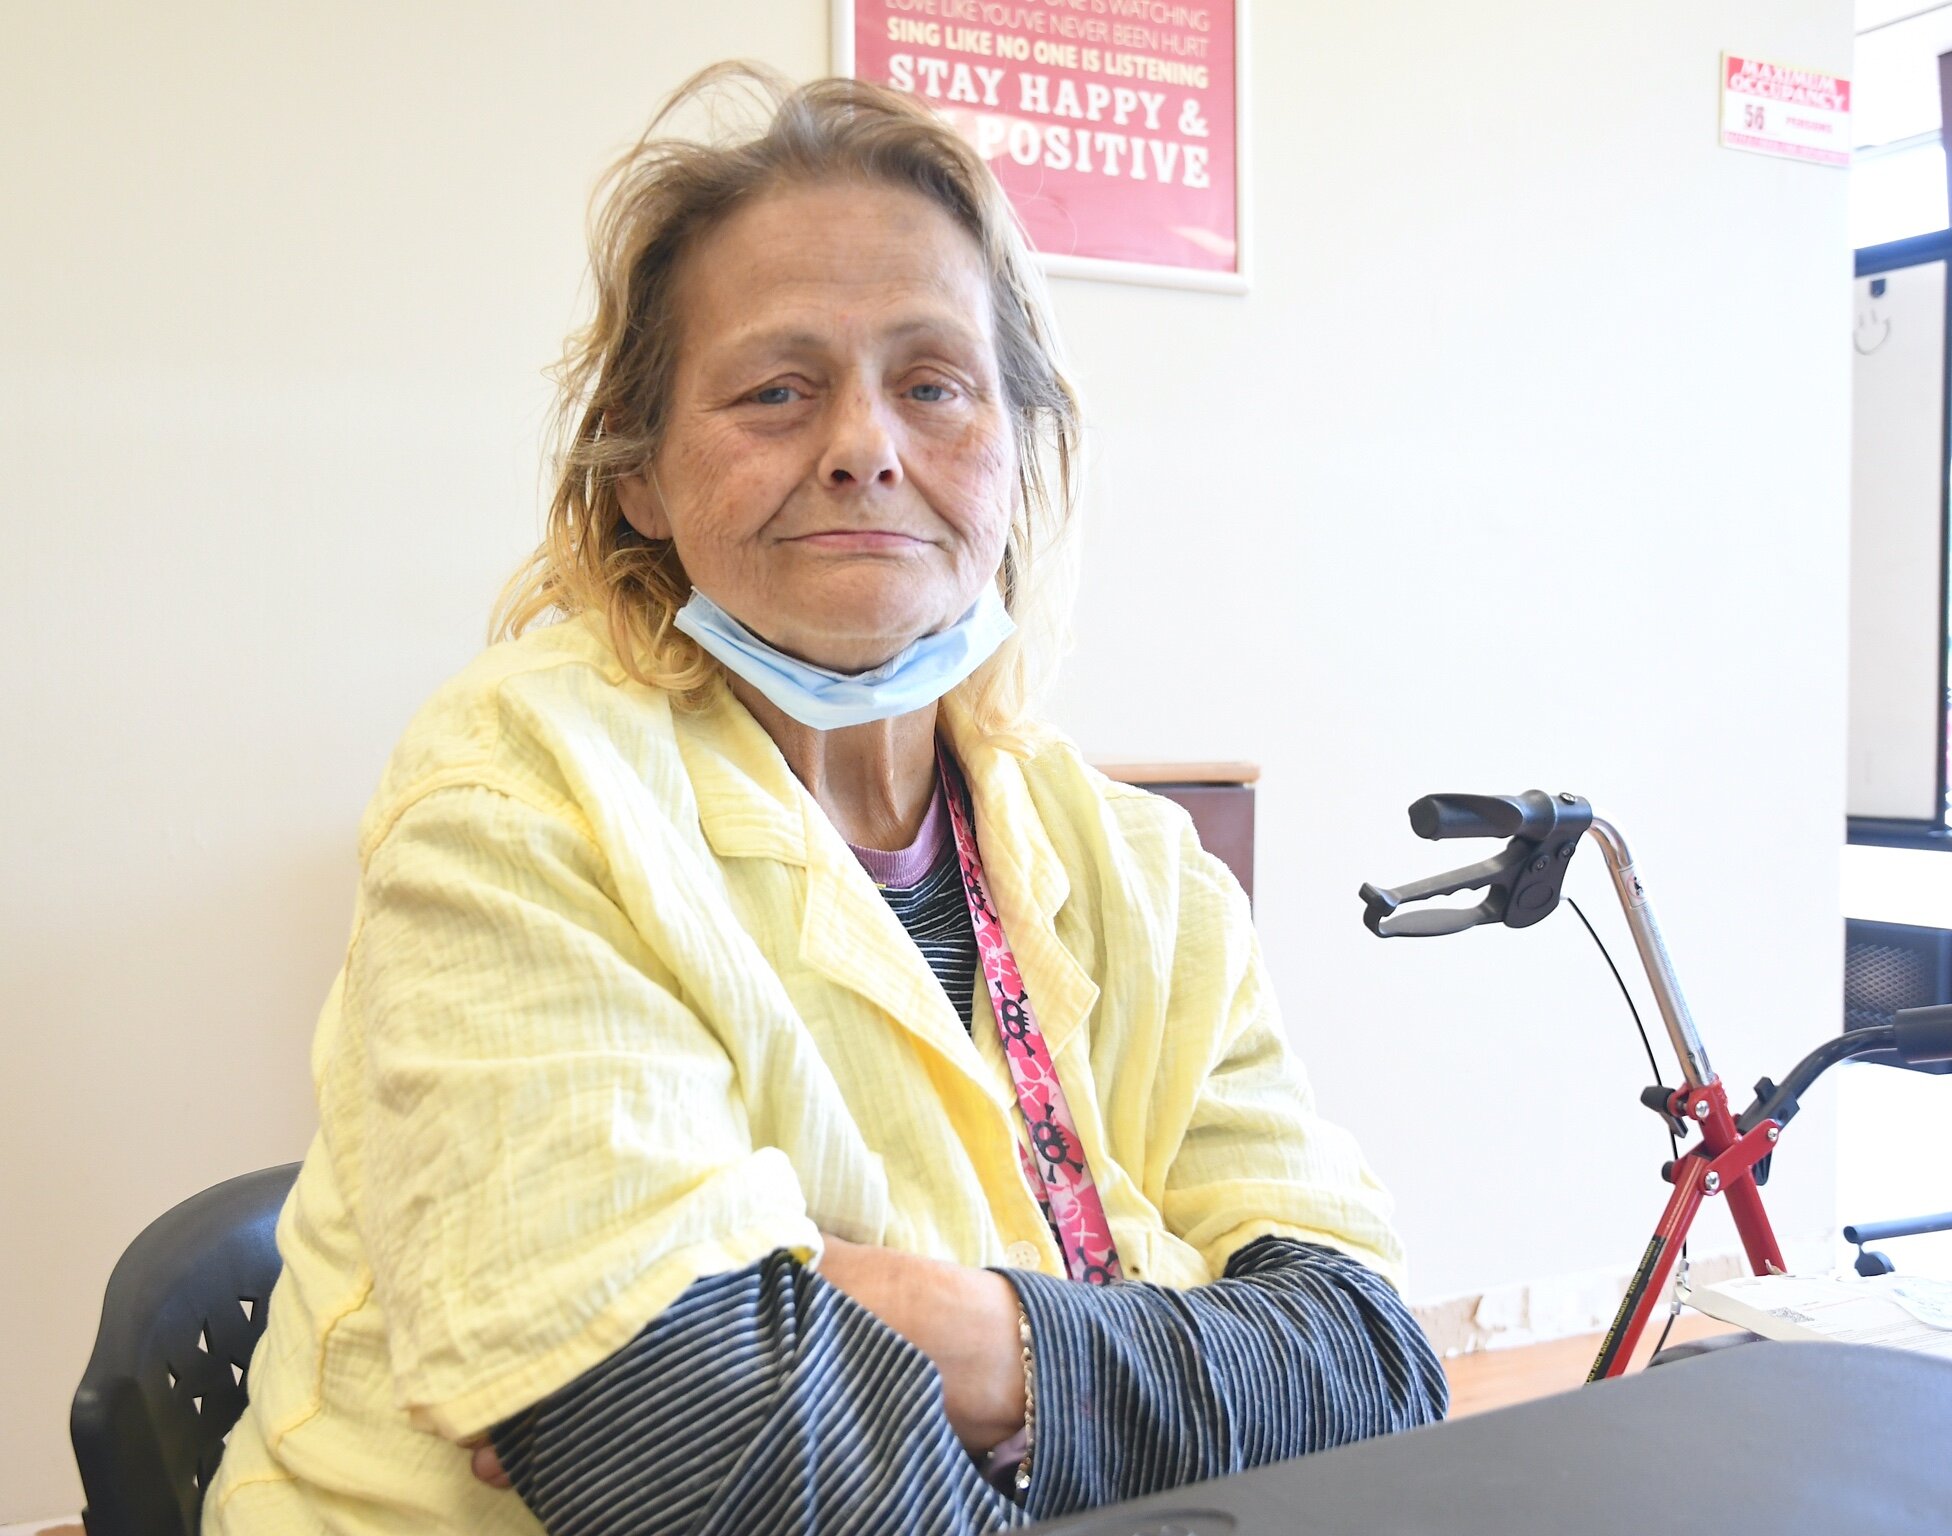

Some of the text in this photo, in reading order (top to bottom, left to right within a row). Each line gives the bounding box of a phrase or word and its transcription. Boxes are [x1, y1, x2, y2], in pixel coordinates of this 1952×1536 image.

[941, 0, 978, 21] LIKE
[979, 1, 1046, 34] YOU'VE
[1049, 14, 1108, 44] NEVER
[1113, 23, 1159, 50] BEEN
[1161, 32, 1209, 57] HURT
[1109, 0, 1209, 32] WATCHING
[887, 16, 1209, 89] SING LIKE NO ONE IS LISTENING
[1740, 59, 1837, 97] MAXIMUM
[888, 53, 1209, 137] STAY HAPPY &
[1729, 72, 1847, 112] OCCUPANCY
[976, 114, 1210, 189] POSITIVE
